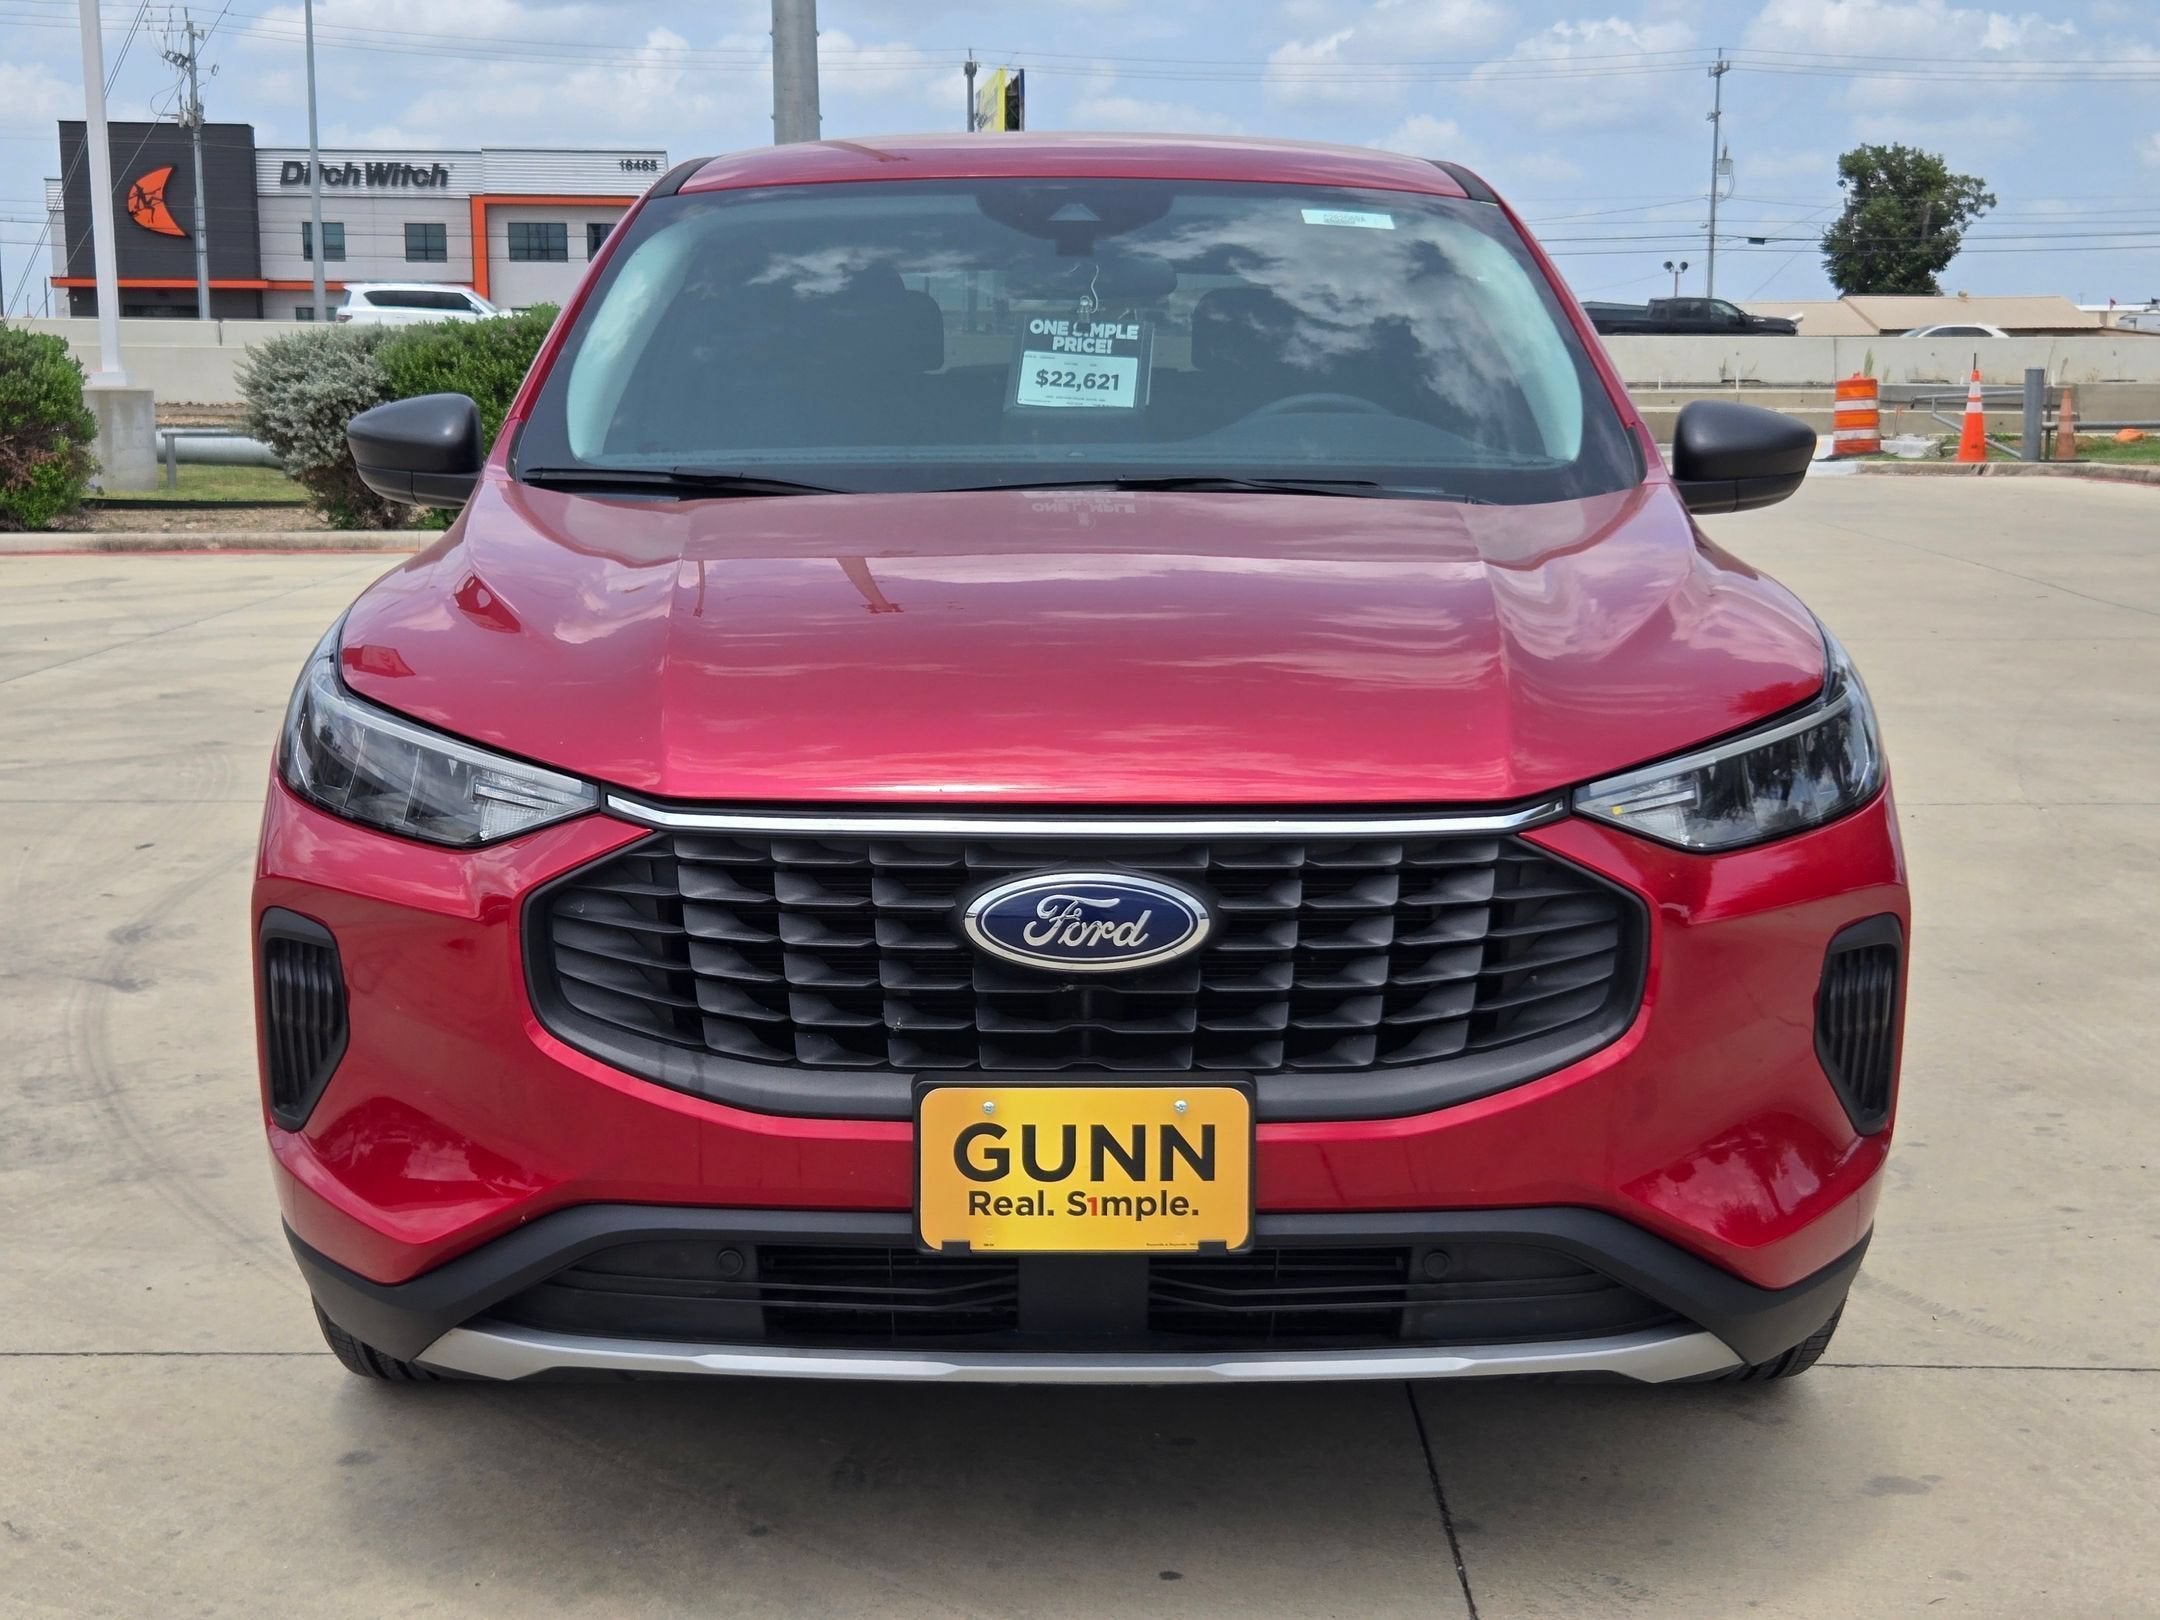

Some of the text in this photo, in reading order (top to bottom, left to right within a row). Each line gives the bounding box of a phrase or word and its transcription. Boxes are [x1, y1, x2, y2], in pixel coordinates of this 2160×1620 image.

[280, 161, 449, 187] Dich Witch
[1030, 319, 1139, 340] ONE MPLE
[1052, 336, 1113, 354] PRICE!
[1035, 368, 1120, 392] $22,621
[1023, 894, 1152, 947] Ford
[953, 1122, 1215, 1182] GUNN
[968, 1190, 1199, 1221] Real. S1mple.
